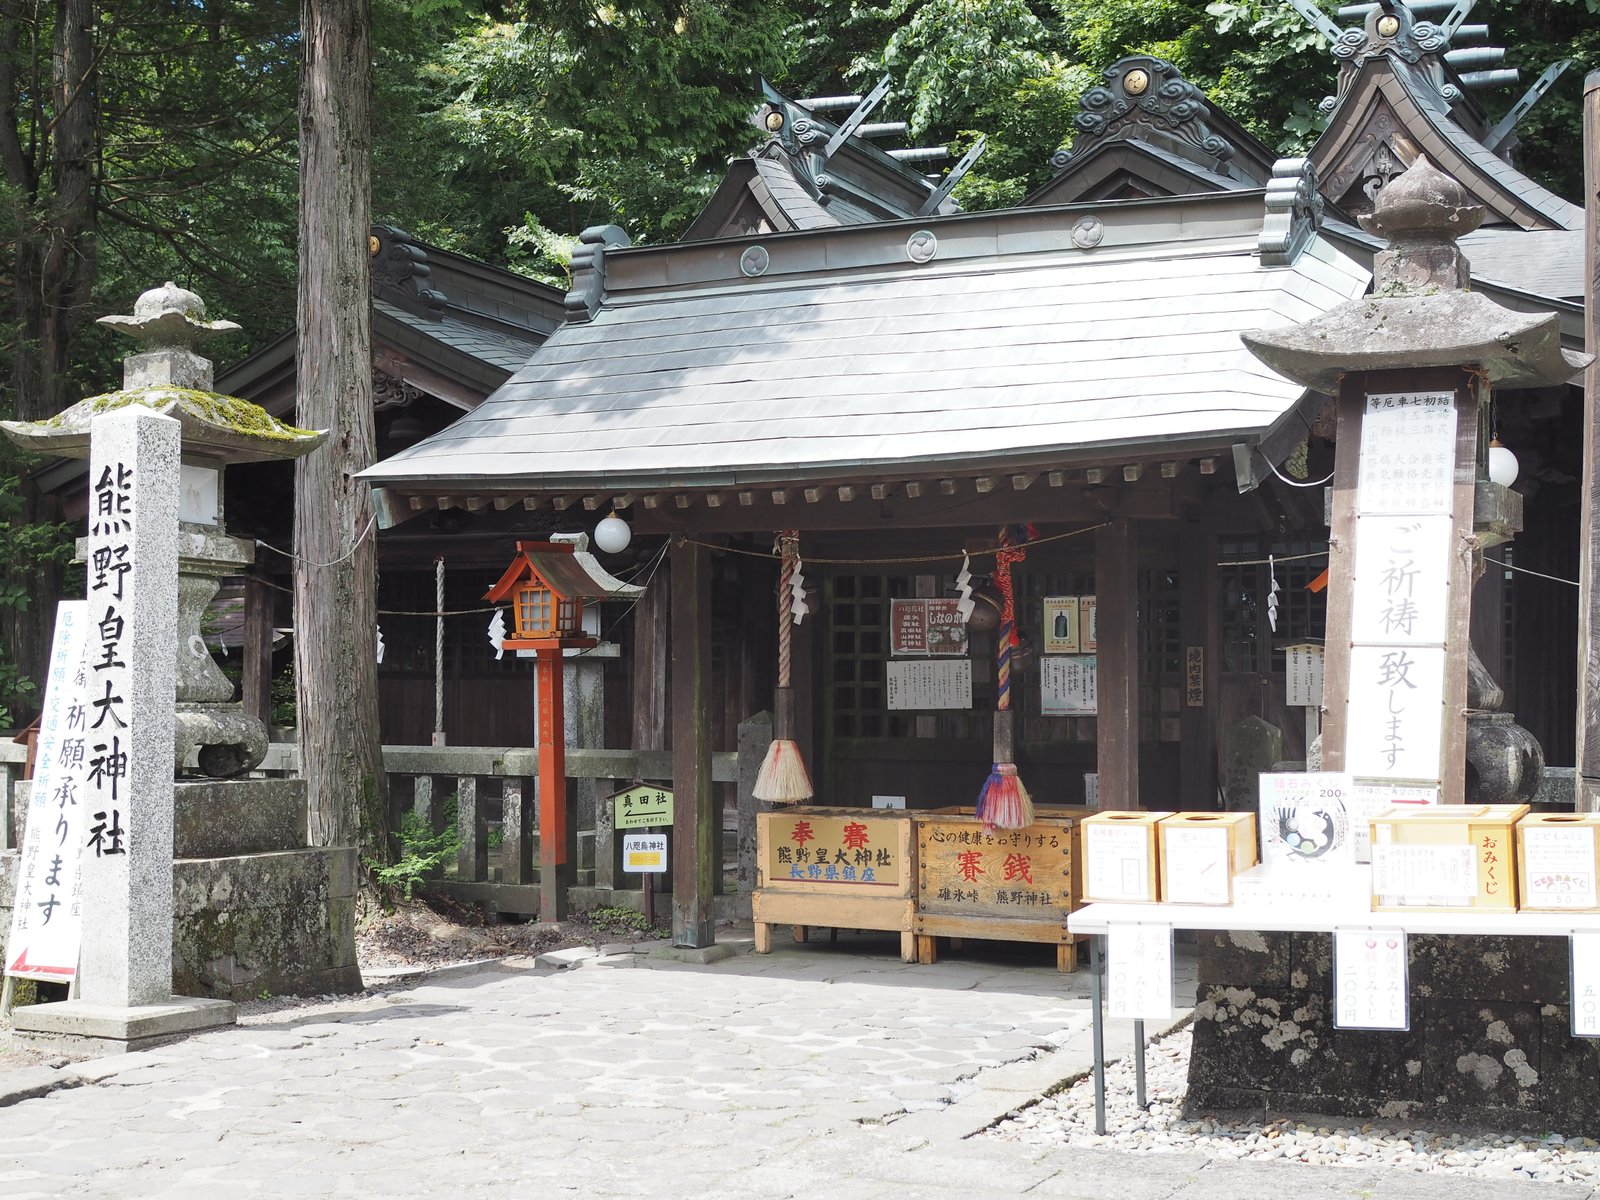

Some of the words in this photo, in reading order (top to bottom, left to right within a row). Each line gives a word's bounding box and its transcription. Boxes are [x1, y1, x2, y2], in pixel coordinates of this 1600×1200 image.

[87, 462, 135, 858] 熊野皇大神社
[33, 611, 74, 808] 厄除祈願・交通安全祈願
[623, 791, 667, 808] 真田社
[777, 846, 892, 867] 熊野皇大神社
[929, 830, 1060, 849] 心の健康をお守りする
[18, 826, 42, 932] 熊野皇大神社
[788, 863, 877, 883] 長野県鎮座
[957, 849, 1033, 884] 賽銭
[1482, 836, 1498, 894] おみくじ
[996, 890, 1053, 907] 熊野神社
[1114, 960, 1128, 1013] 一〇〇円
[1343, 965, 1358, 1022] 二〇〇円
[1582, 984, 1597, 1030] 五〇円
